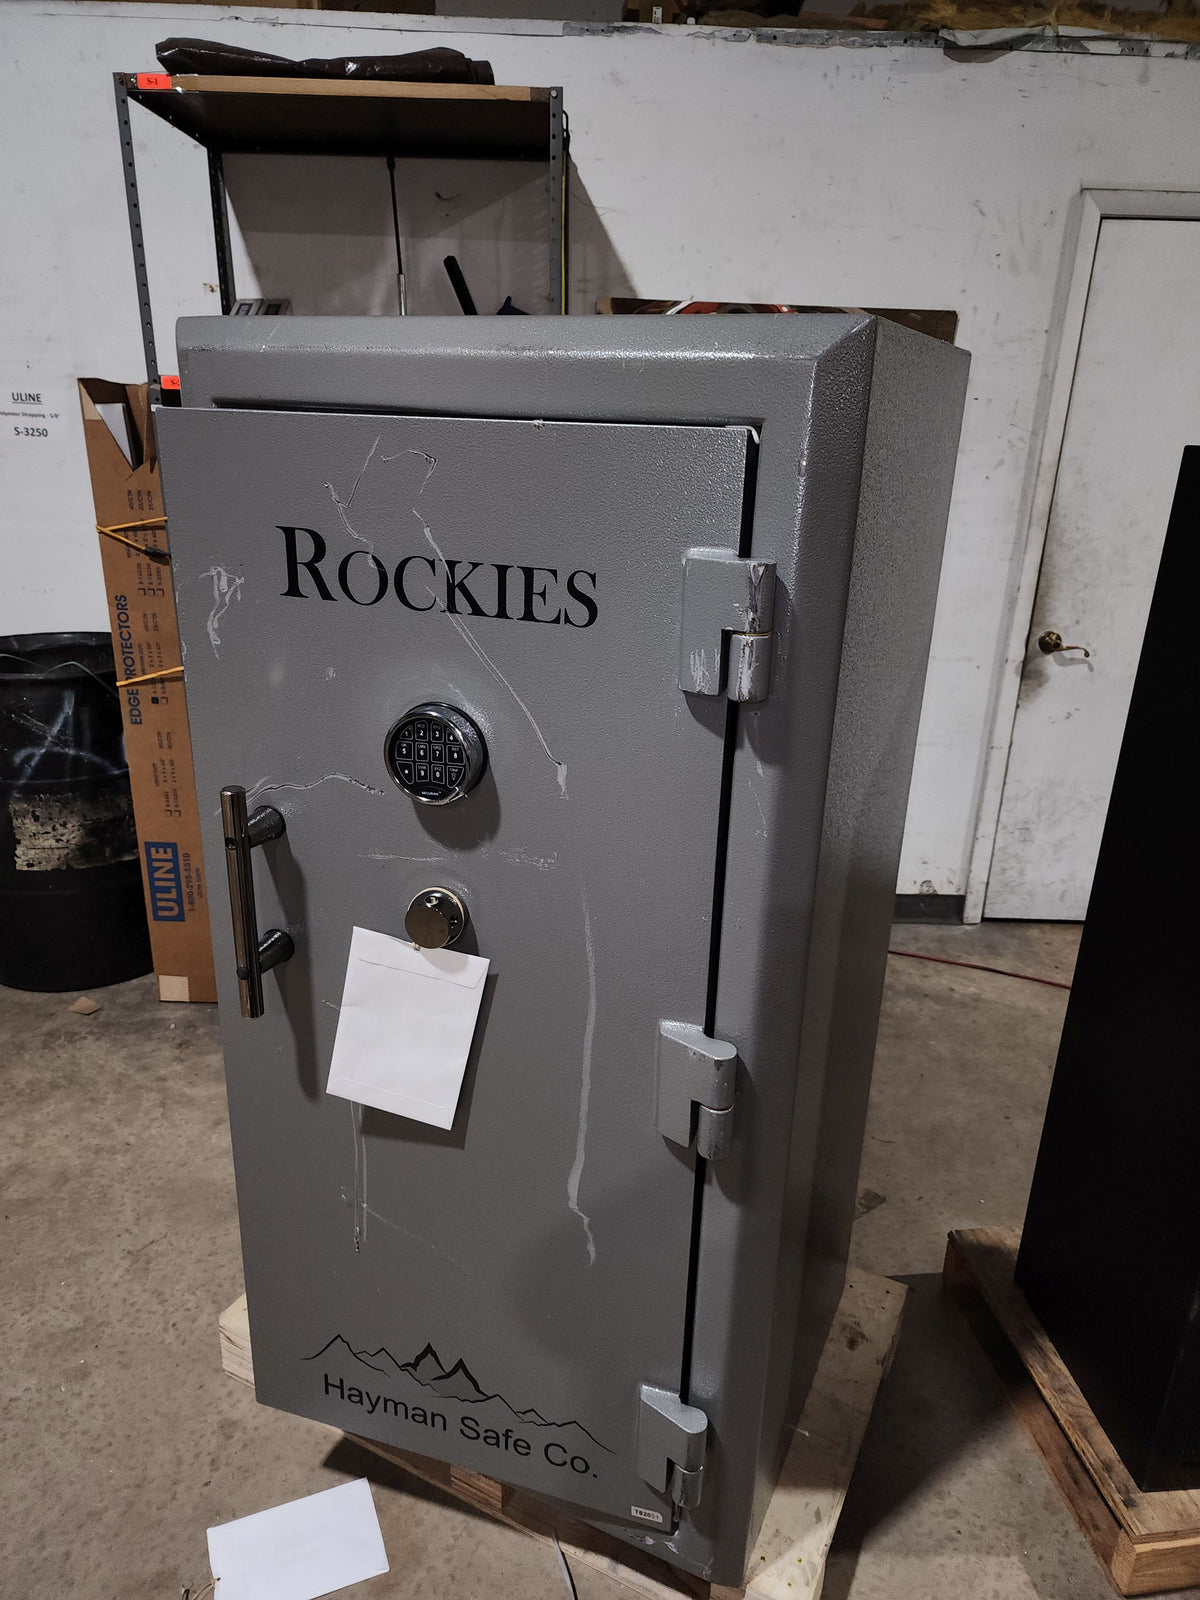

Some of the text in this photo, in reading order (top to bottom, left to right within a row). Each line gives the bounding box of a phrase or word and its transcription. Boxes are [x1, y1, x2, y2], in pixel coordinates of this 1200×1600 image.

[146, 77, 158, 86] S-1
[11, 392, 43, 404] ULINE
[14, 426, 48, 437] S-3250
[274, 525, 598, 628] ROCKIES
[127, 689, 143, 725] EDGE
[150, 847, 179, 917] ULINE
[182, 852, 196, 913] 1-800-295-5510
[323, 1373, 600, 1479] Hayman Safe Co.
